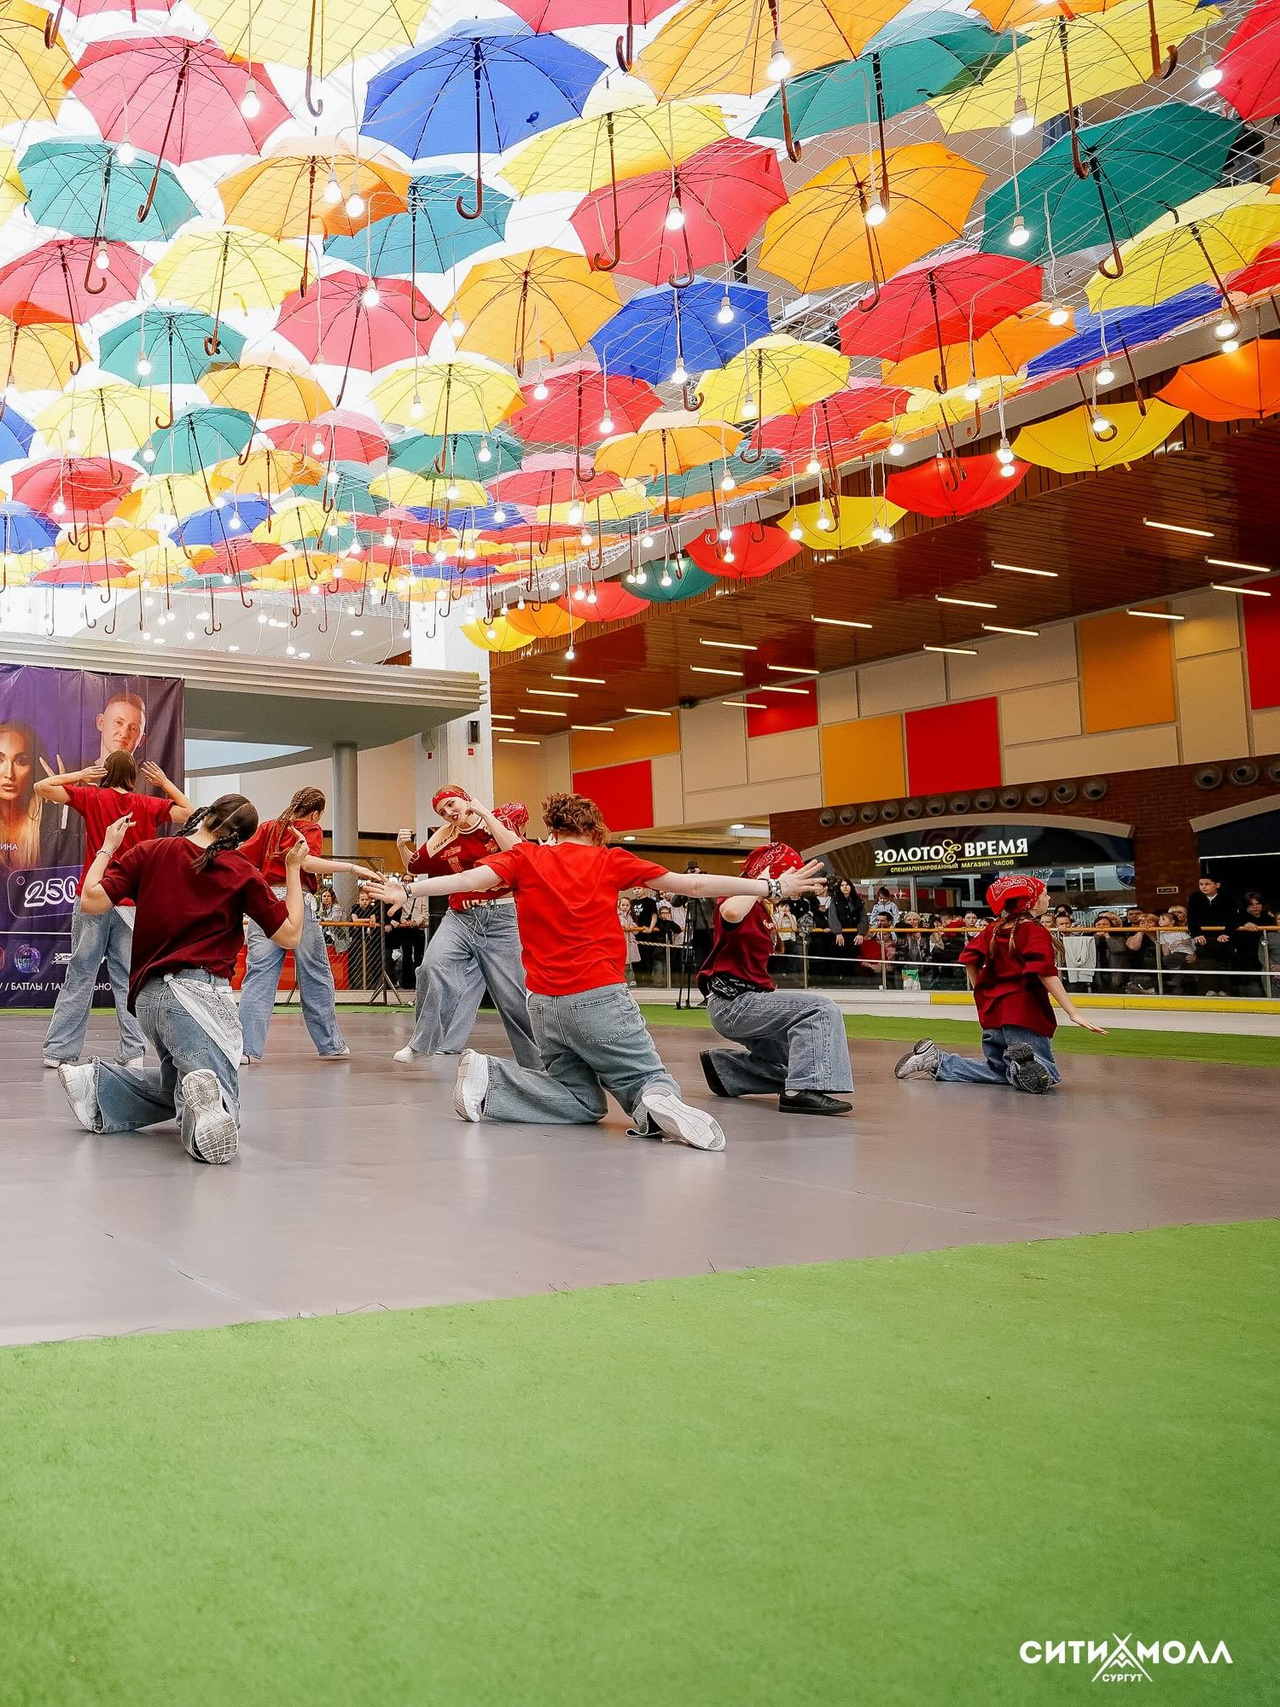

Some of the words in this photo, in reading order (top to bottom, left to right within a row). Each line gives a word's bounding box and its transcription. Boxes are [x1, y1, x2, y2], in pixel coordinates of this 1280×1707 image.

[874, 845, 944, 864] ЗОЛОТО
[964, 837, 1028, 858] ВРЕМЯ
[961, 860, 990, 869] МАГАЗИН
[11, 982, 43, 991] БАТТЛЫ
